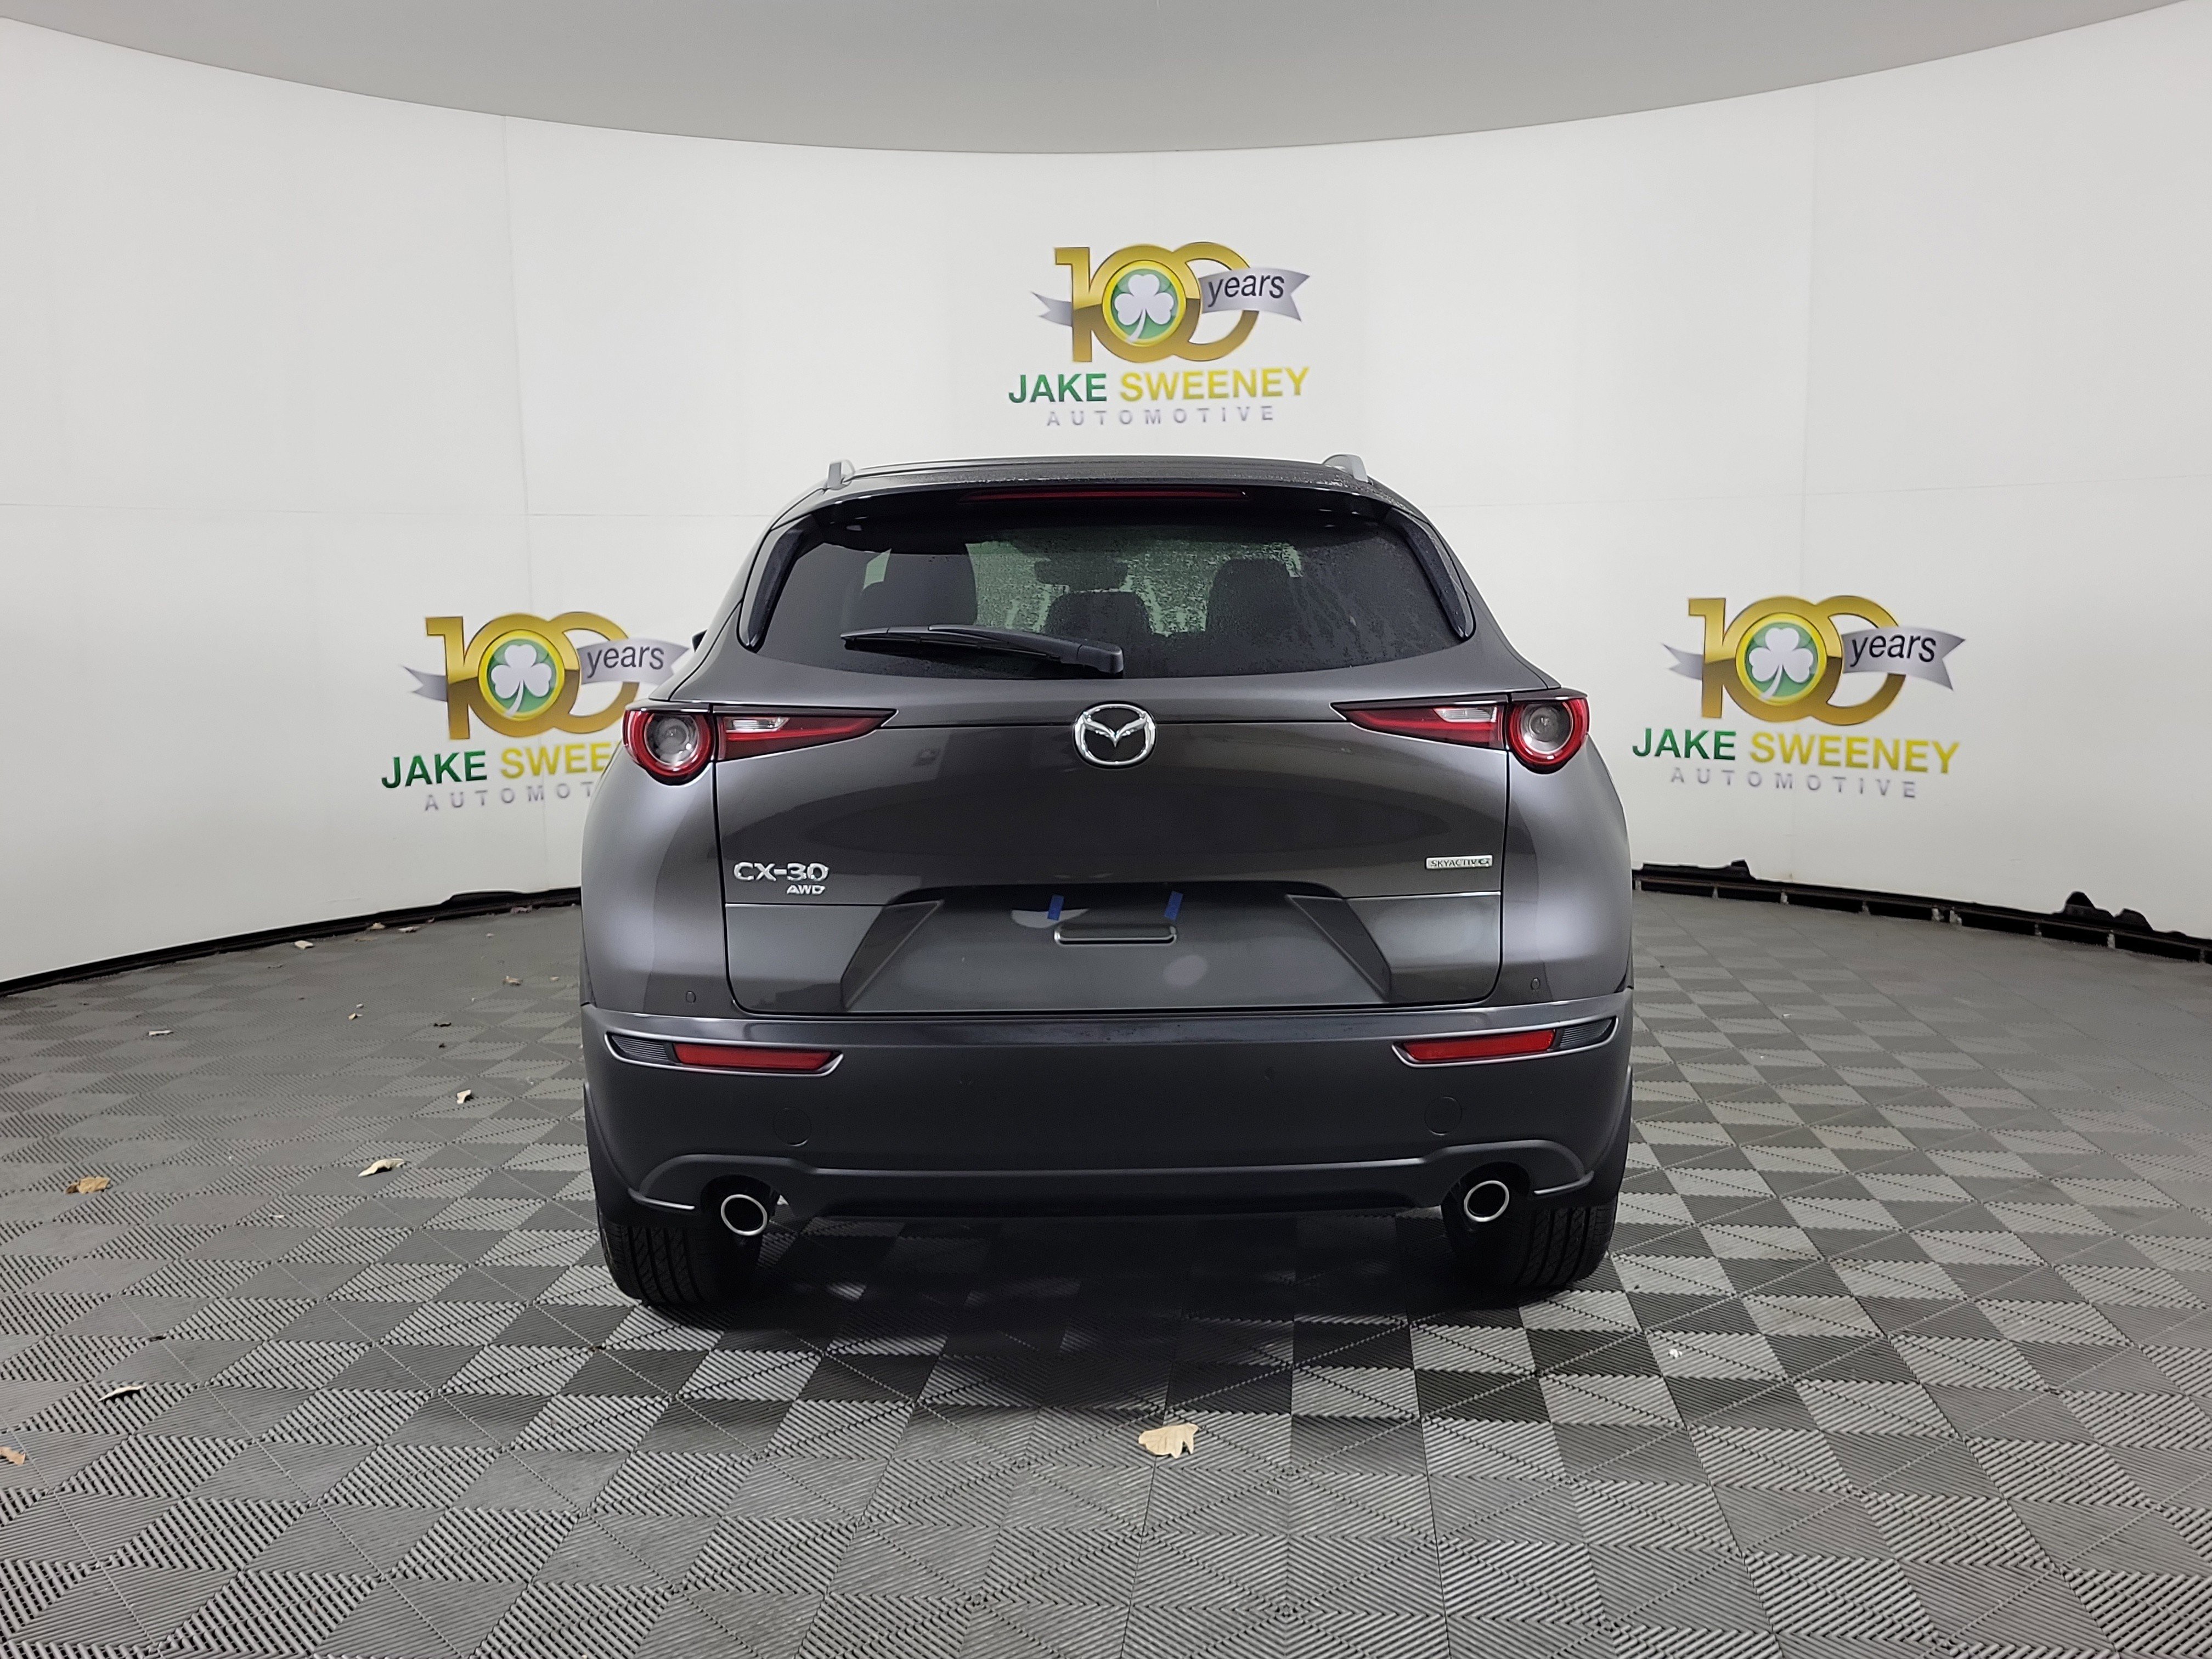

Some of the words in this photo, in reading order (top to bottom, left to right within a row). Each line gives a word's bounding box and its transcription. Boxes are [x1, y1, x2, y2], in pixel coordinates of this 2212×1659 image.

[1207, 274, 1285, 308] years
[1008, 373, 1107, 403] JAKE
[1120, 367, 1310, 402] SWEENEY
[1047, 406, 1273, 426] AUTOMOTIVE
[587, 645, 665, 678] years
[1849, 633, 1937, 667] years
[381, 750, 487, 788] JAKE
[500, 741, 621, 780] SWEE
[1632, 727, 1736, 761] JAKE
[1750, 731, 1960, 774] SWEENEY
[424, 781, 594, 811] AUTOMOT
[1671, 768, 1917, 799] AUTOMOTIVE
[733, 861, 829, 882] CX-30
[786, 884, 826, 895] AWD
